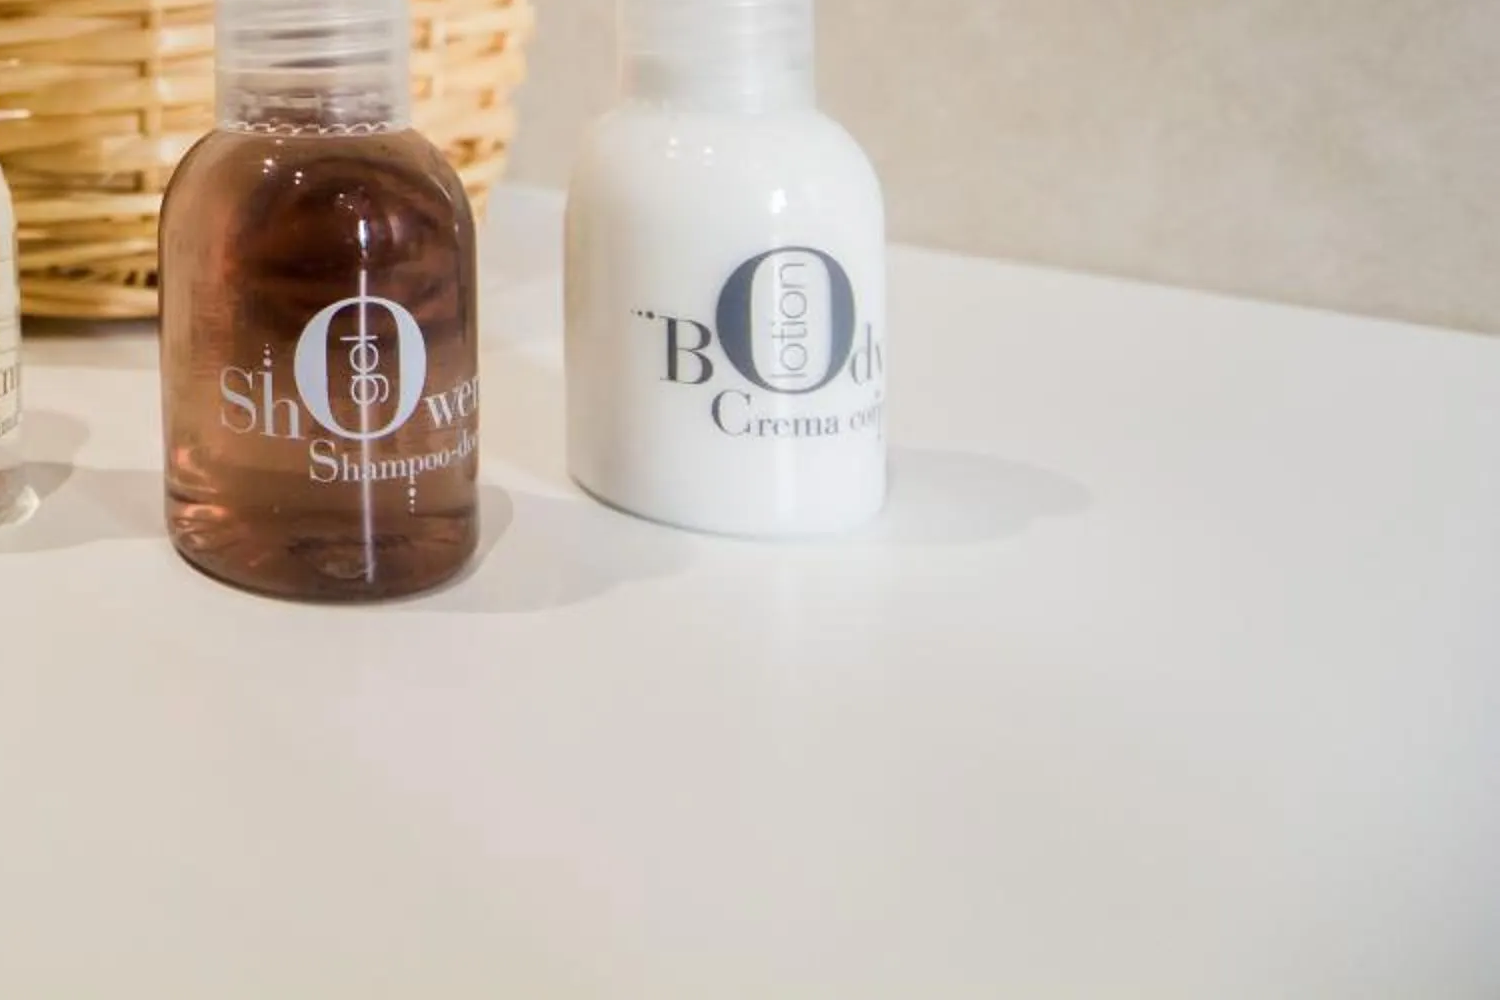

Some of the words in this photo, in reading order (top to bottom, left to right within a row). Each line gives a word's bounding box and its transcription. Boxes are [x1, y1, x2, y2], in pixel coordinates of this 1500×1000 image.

[769, 261, 808, 380] lotion
[339, 335, 389, 405] gel
[711, 388, 839, 437] Crema
